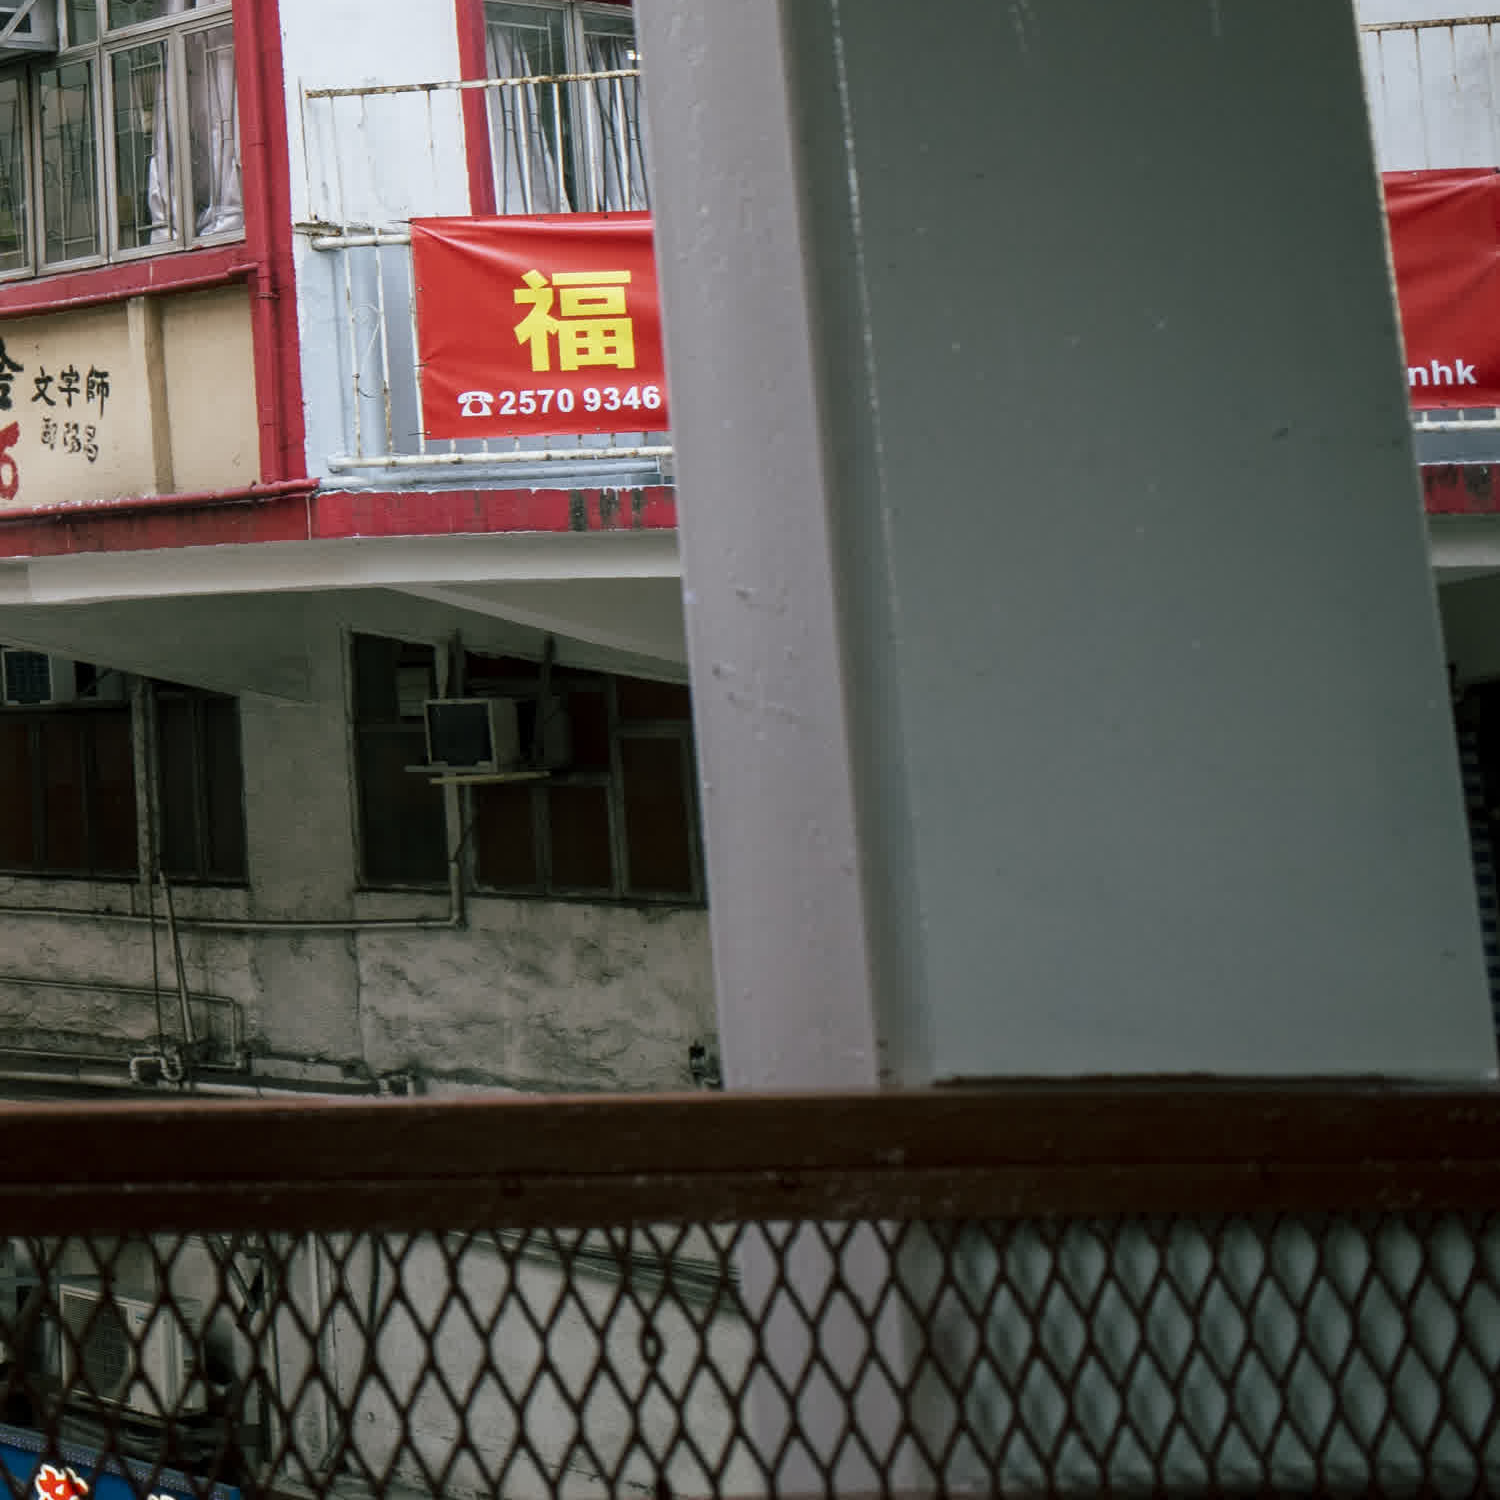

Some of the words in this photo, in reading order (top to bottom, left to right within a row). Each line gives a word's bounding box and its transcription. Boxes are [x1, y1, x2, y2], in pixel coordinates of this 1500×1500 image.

[513, 269, 636, 372] 福
[31, 364, 111, 419] 文字師
[499, 389, 575, 415] 2570
[583, 385, 661, 411] 9346
